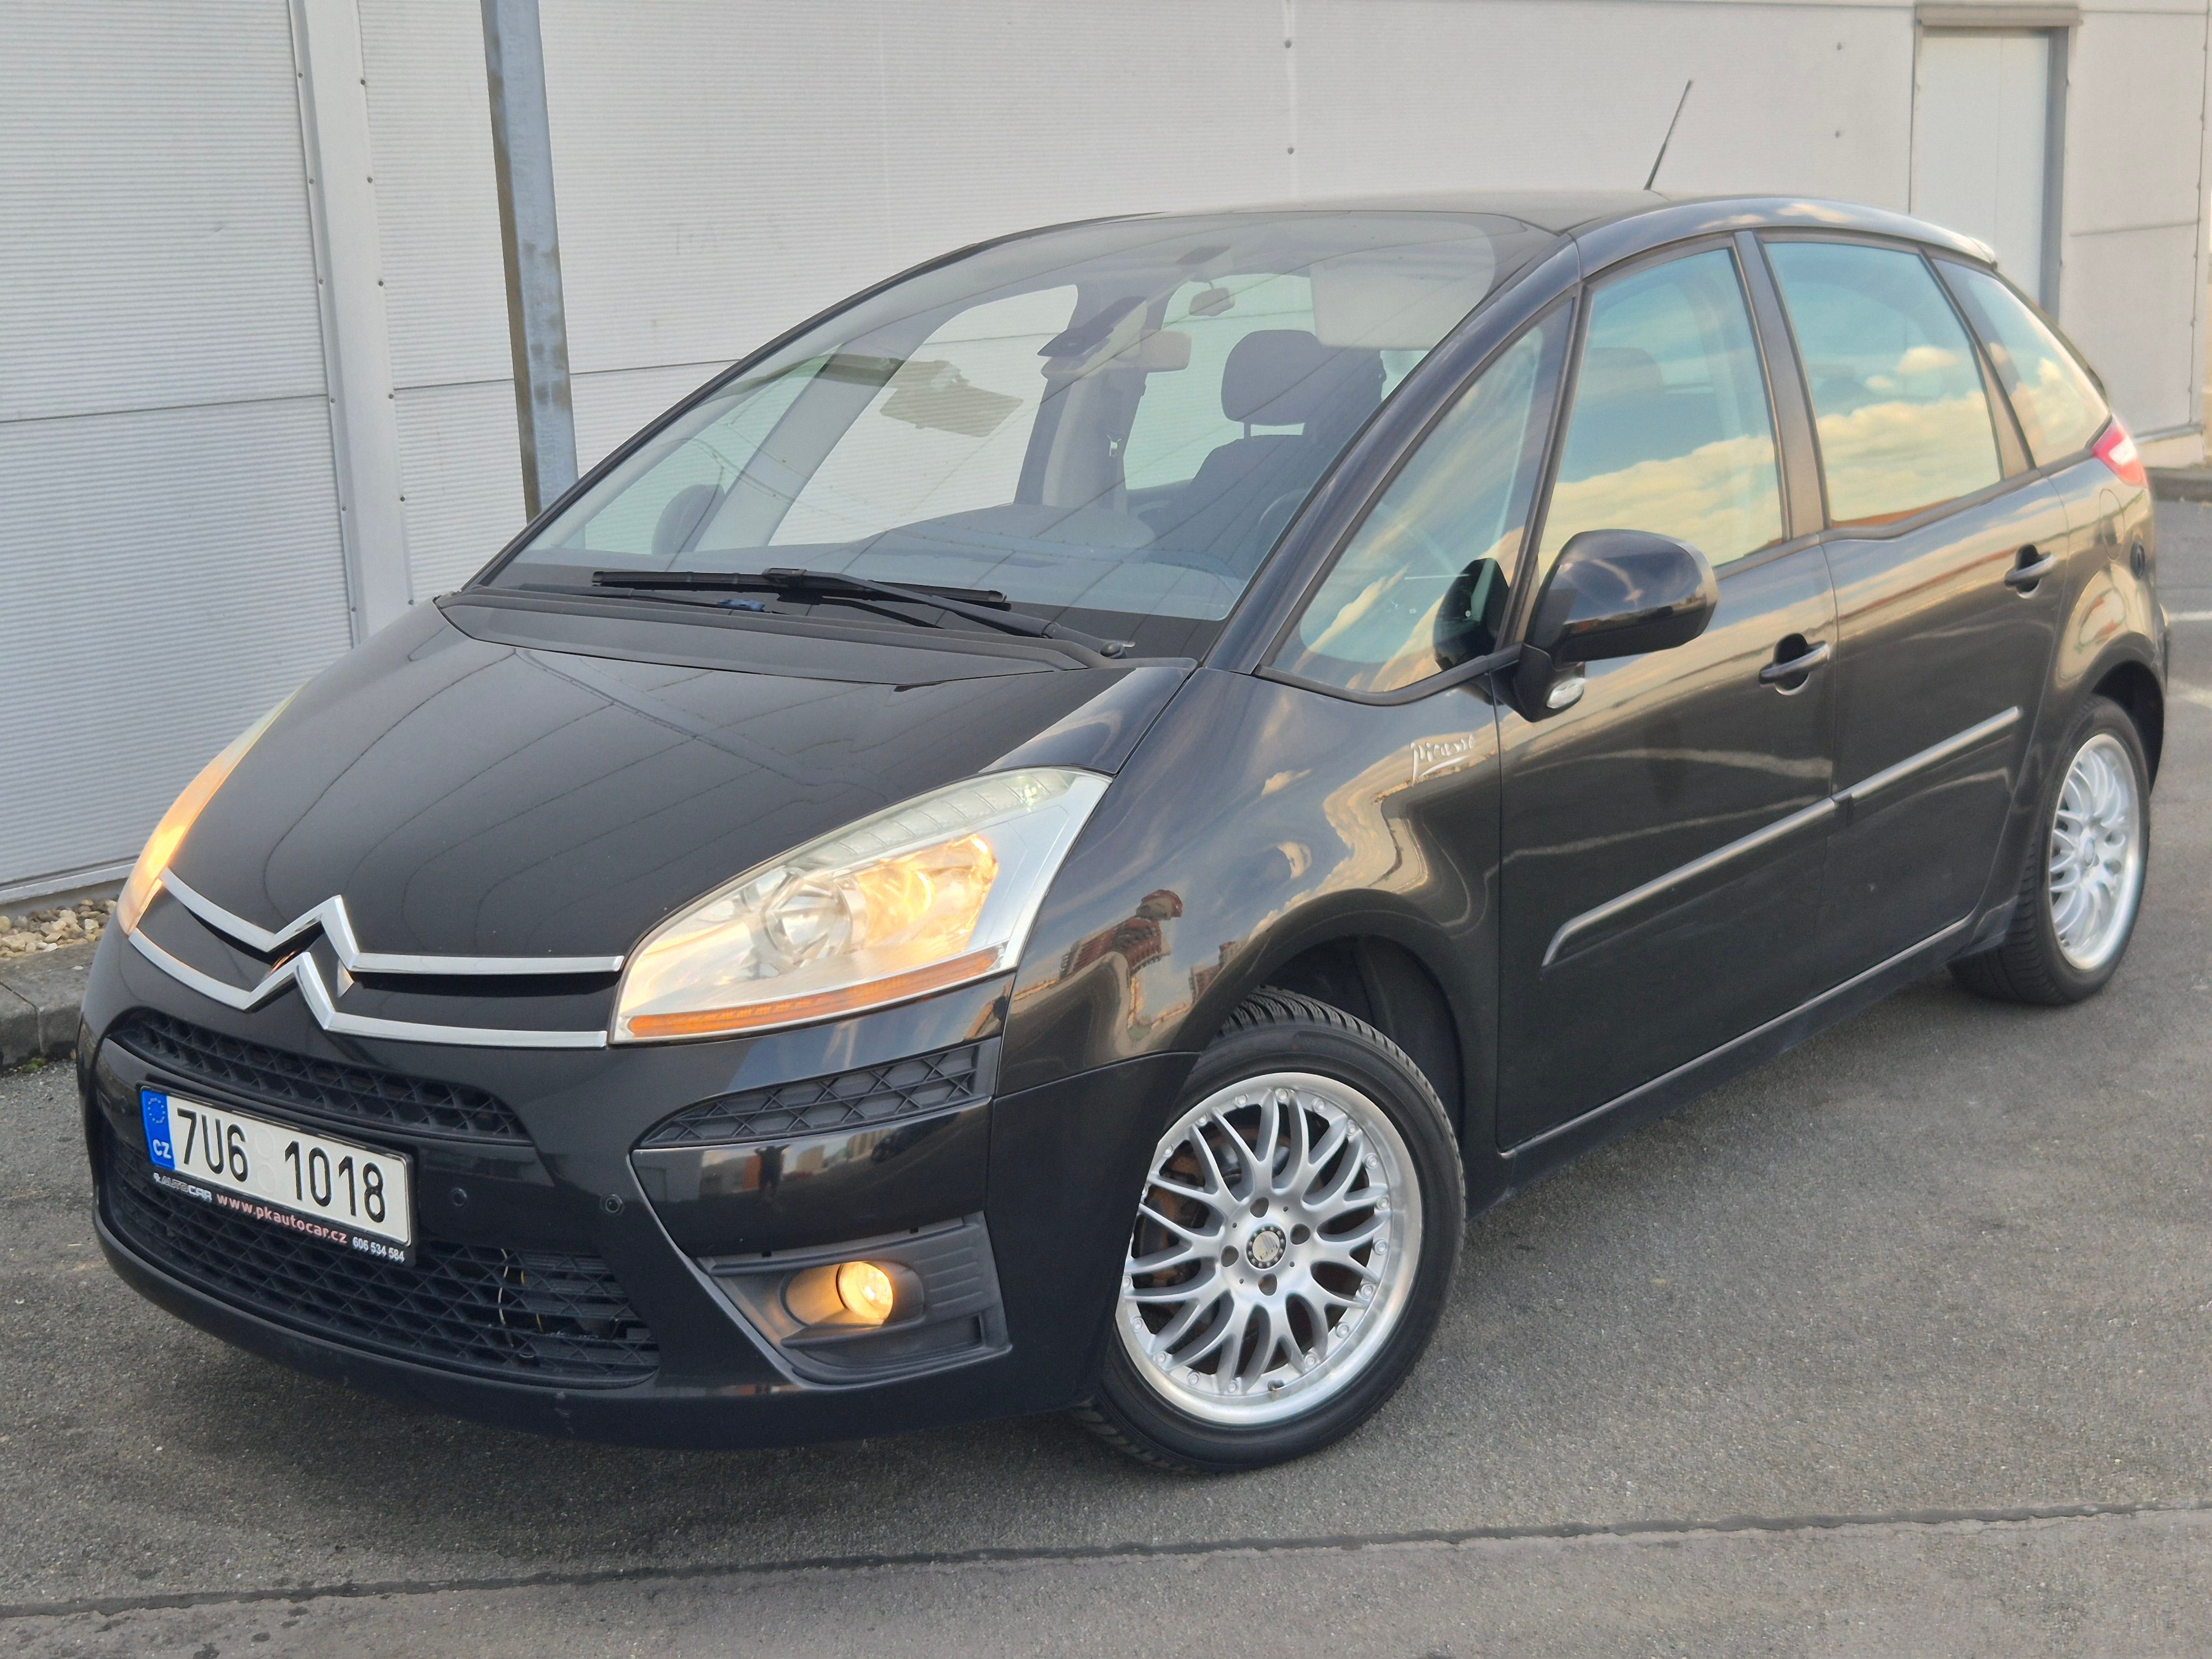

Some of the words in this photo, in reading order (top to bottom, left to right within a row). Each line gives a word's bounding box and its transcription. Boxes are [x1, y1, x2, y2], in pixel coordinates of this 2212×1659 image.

[153, 1139, 172, 1159] CZ
[177, 1107, 248, 1182] 7U6
[285, 1140, 386, 1223] 1018
[216, 1193, 348, 1245] www.pkautocar.cz
[352, 1236, 369, 1253] 606
